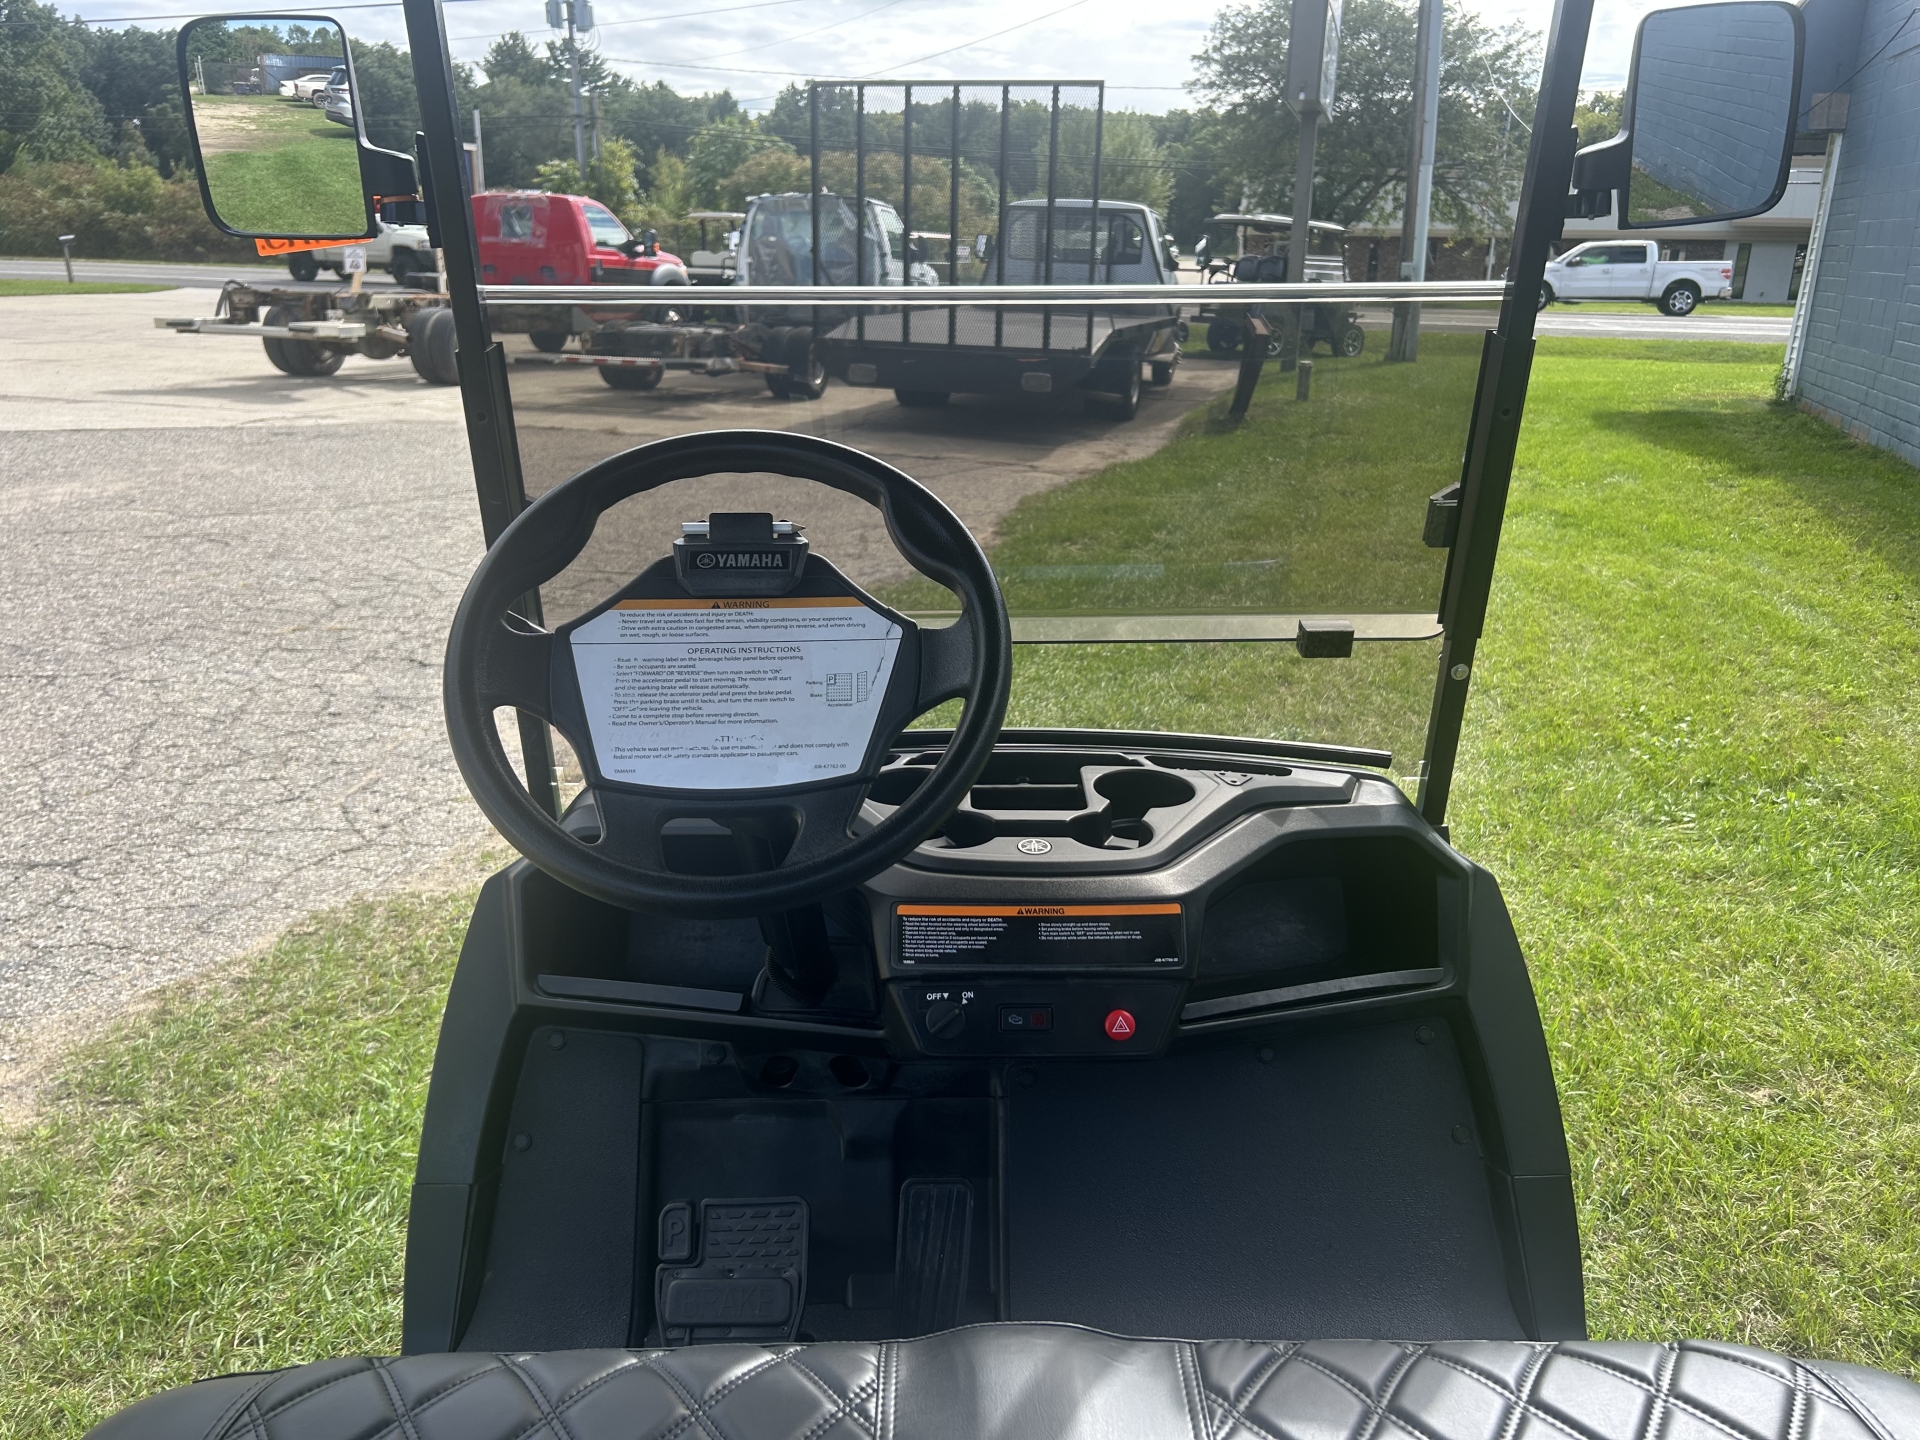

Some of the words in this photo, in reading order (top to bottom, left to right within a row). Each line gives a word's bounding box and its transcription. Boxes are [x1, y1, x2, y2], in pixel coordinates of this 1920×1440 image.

[717, 553, 783, 567] YAMAHA
[723, 601, 770, 609] WARNING
[694, 624, 726, 632] congested
[760, 623, 789, 631] operating
[846, 622, 866, 630] driving
[687, 647, 737, 655] OPERATING
[738, 646, 801, 654] INSTRUCTIONS
[641, 656, 665, 664] warning
[697, 655, 724, 663] beverage
[742, 655, 759, 663] panel
[637, 684, 660, 692] parking
[701, 690, 719, 698] pedal
[639, 698, 663, 706] parking
[648, 705, 671, 713] leaving
[642, 712, 671, 720] complete
[705, 711, 733, 719] reversing
[638, 719, 695, 727] Owner's/Operator's
[814, 742, 836, 750] comply
[1024, 907, 1065, 915] WARNING
[926, 992, 942, 1000] OFF
[961, 990, 975, 999] ON
[668, 1218, 685, 1247] P
[679, 1287, 773, 1318] BRAKE
